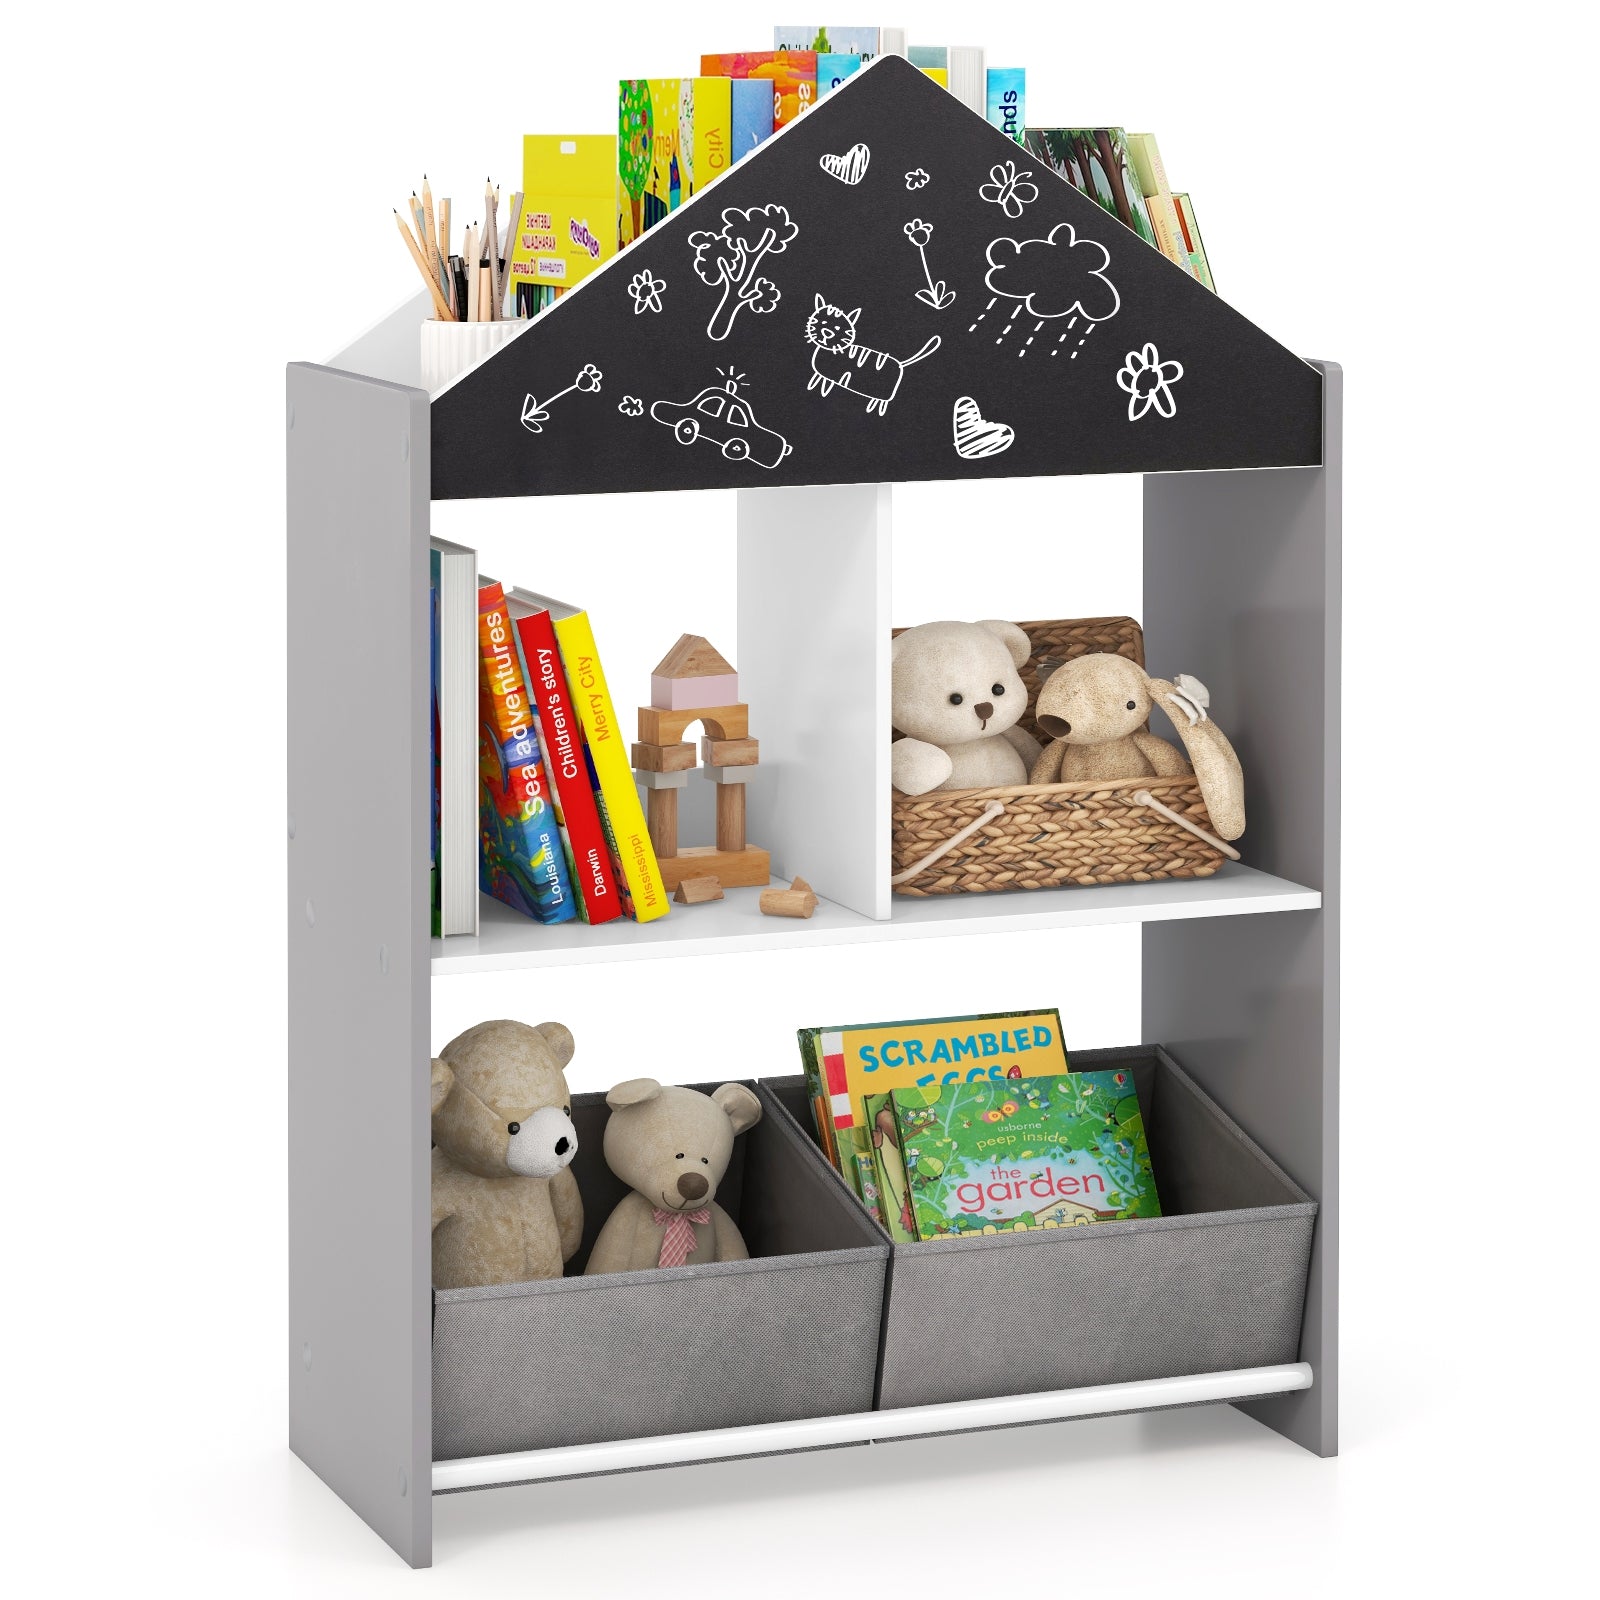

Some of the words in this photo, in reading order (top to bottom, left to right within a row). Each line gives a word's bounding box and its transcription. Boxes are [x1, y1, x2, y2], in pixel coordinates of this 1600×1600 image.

[487, 611, 532, 757] adventures
[536, 648, 557, 690] story
[578, 656, 596, 689] City
[547, 693, 578, 779] Children's
[588, 693, 611, 742] Merry
[521, 762, 545, 816] Sea
[539, 832, 564, 905] Louisiana
[587, 848, 607, 897] Darwin
[627, 833, 657, 908] Mississippi
[859, 1025, 1053, 1073] SCRAMBLED
[976, 1135, 1017, 1151] peep
[1022, 1131, 1069, 1144] inside
[997, 1122, 1042, 1132] usborne
[956, 1166, 1105, 1213] garden
[990, 1165, 1022, 1180] the
